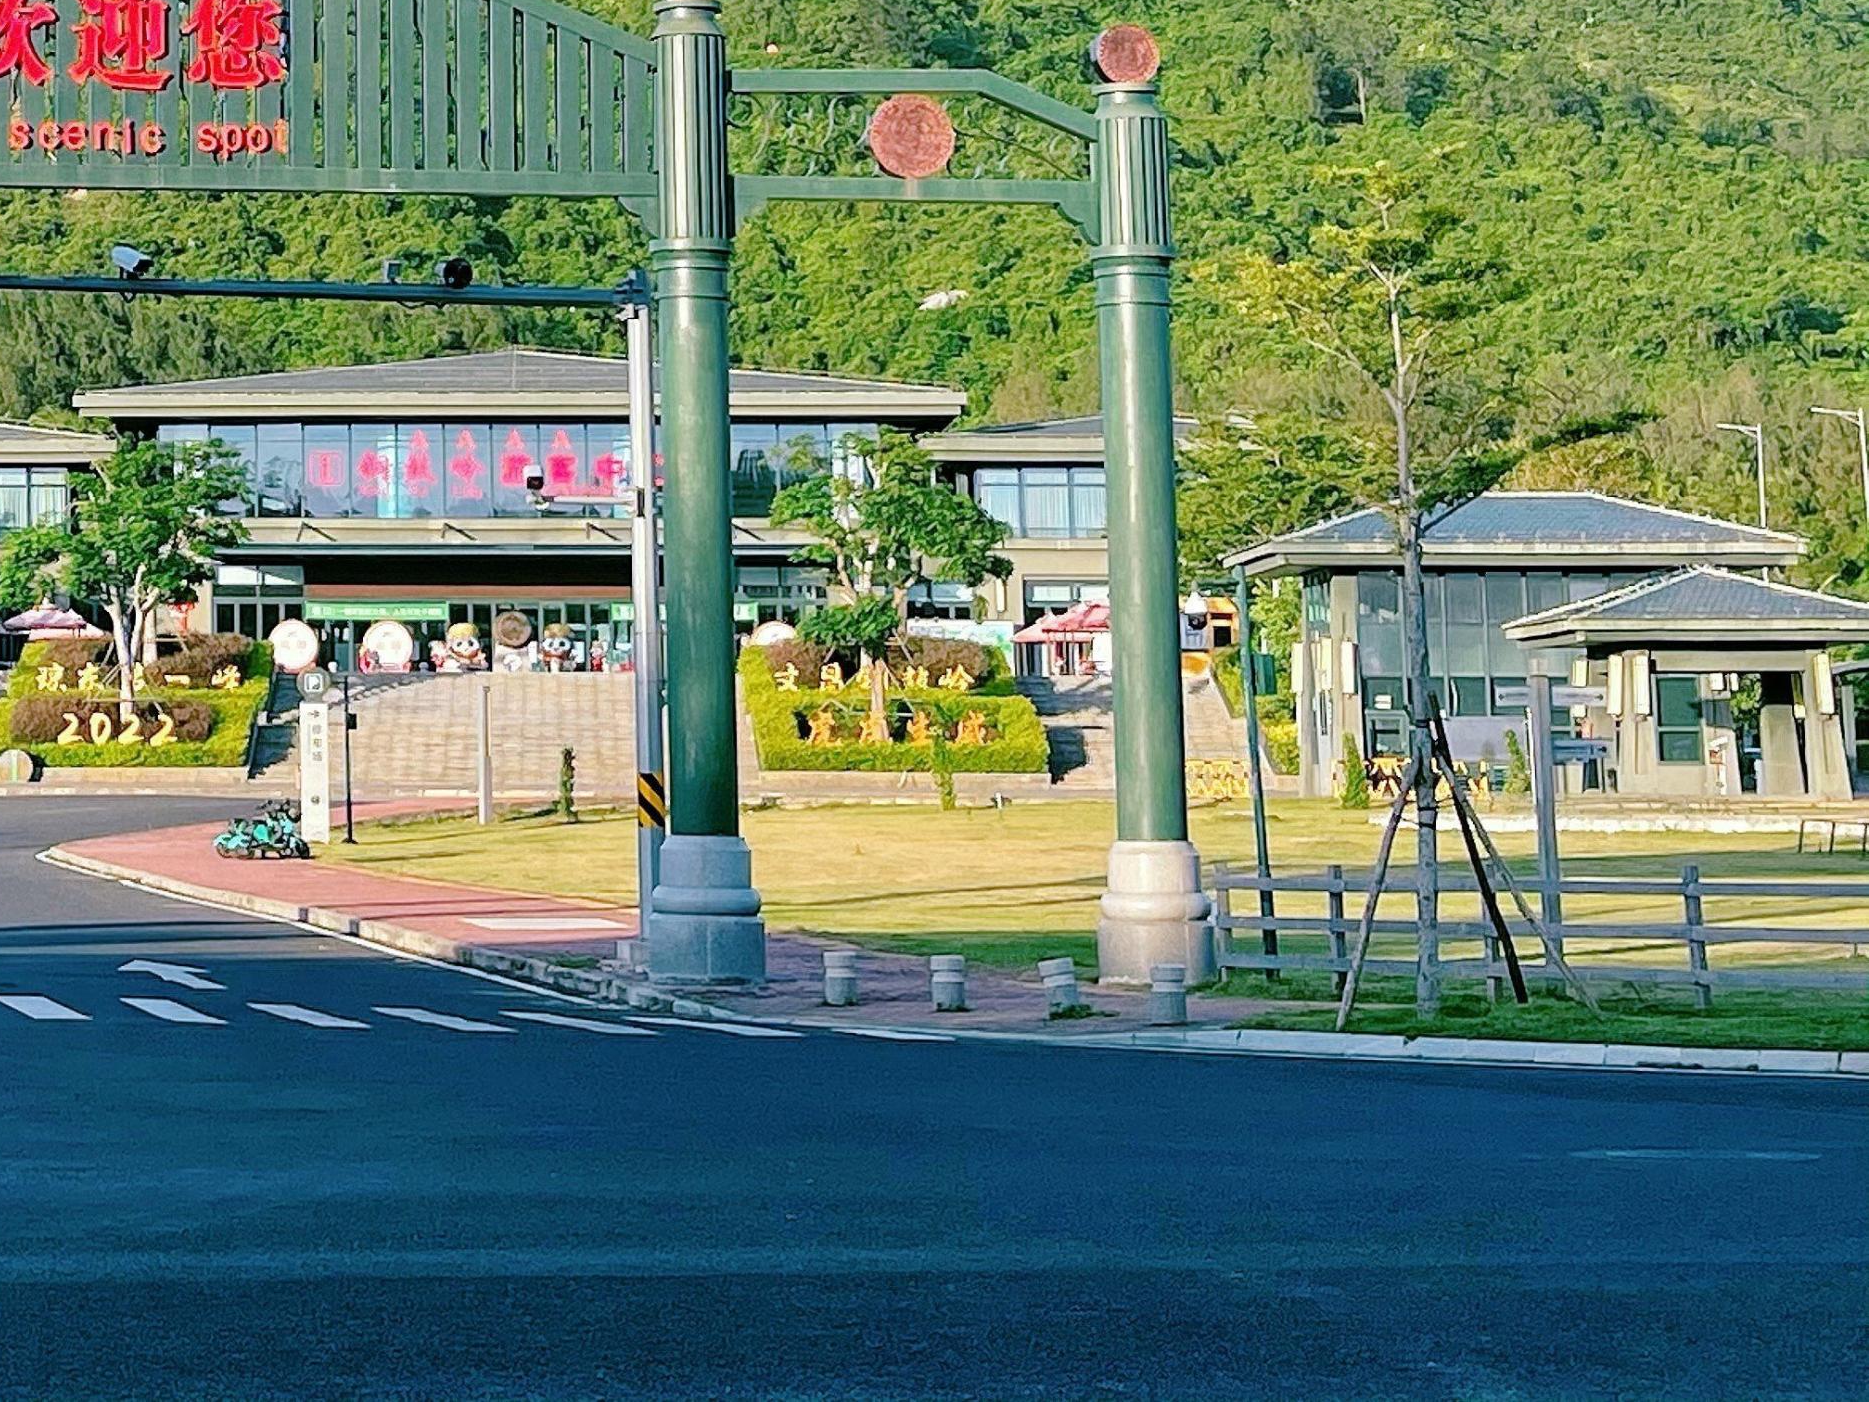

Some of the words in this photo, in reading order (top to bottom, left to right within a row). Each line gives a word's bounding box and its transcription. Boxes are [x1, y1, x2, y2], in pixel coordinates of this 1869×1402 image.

[7, 118, 167, 155] scenic
[196, 118, 289, 160] spot
[58, 712, 178, 746] 2022
